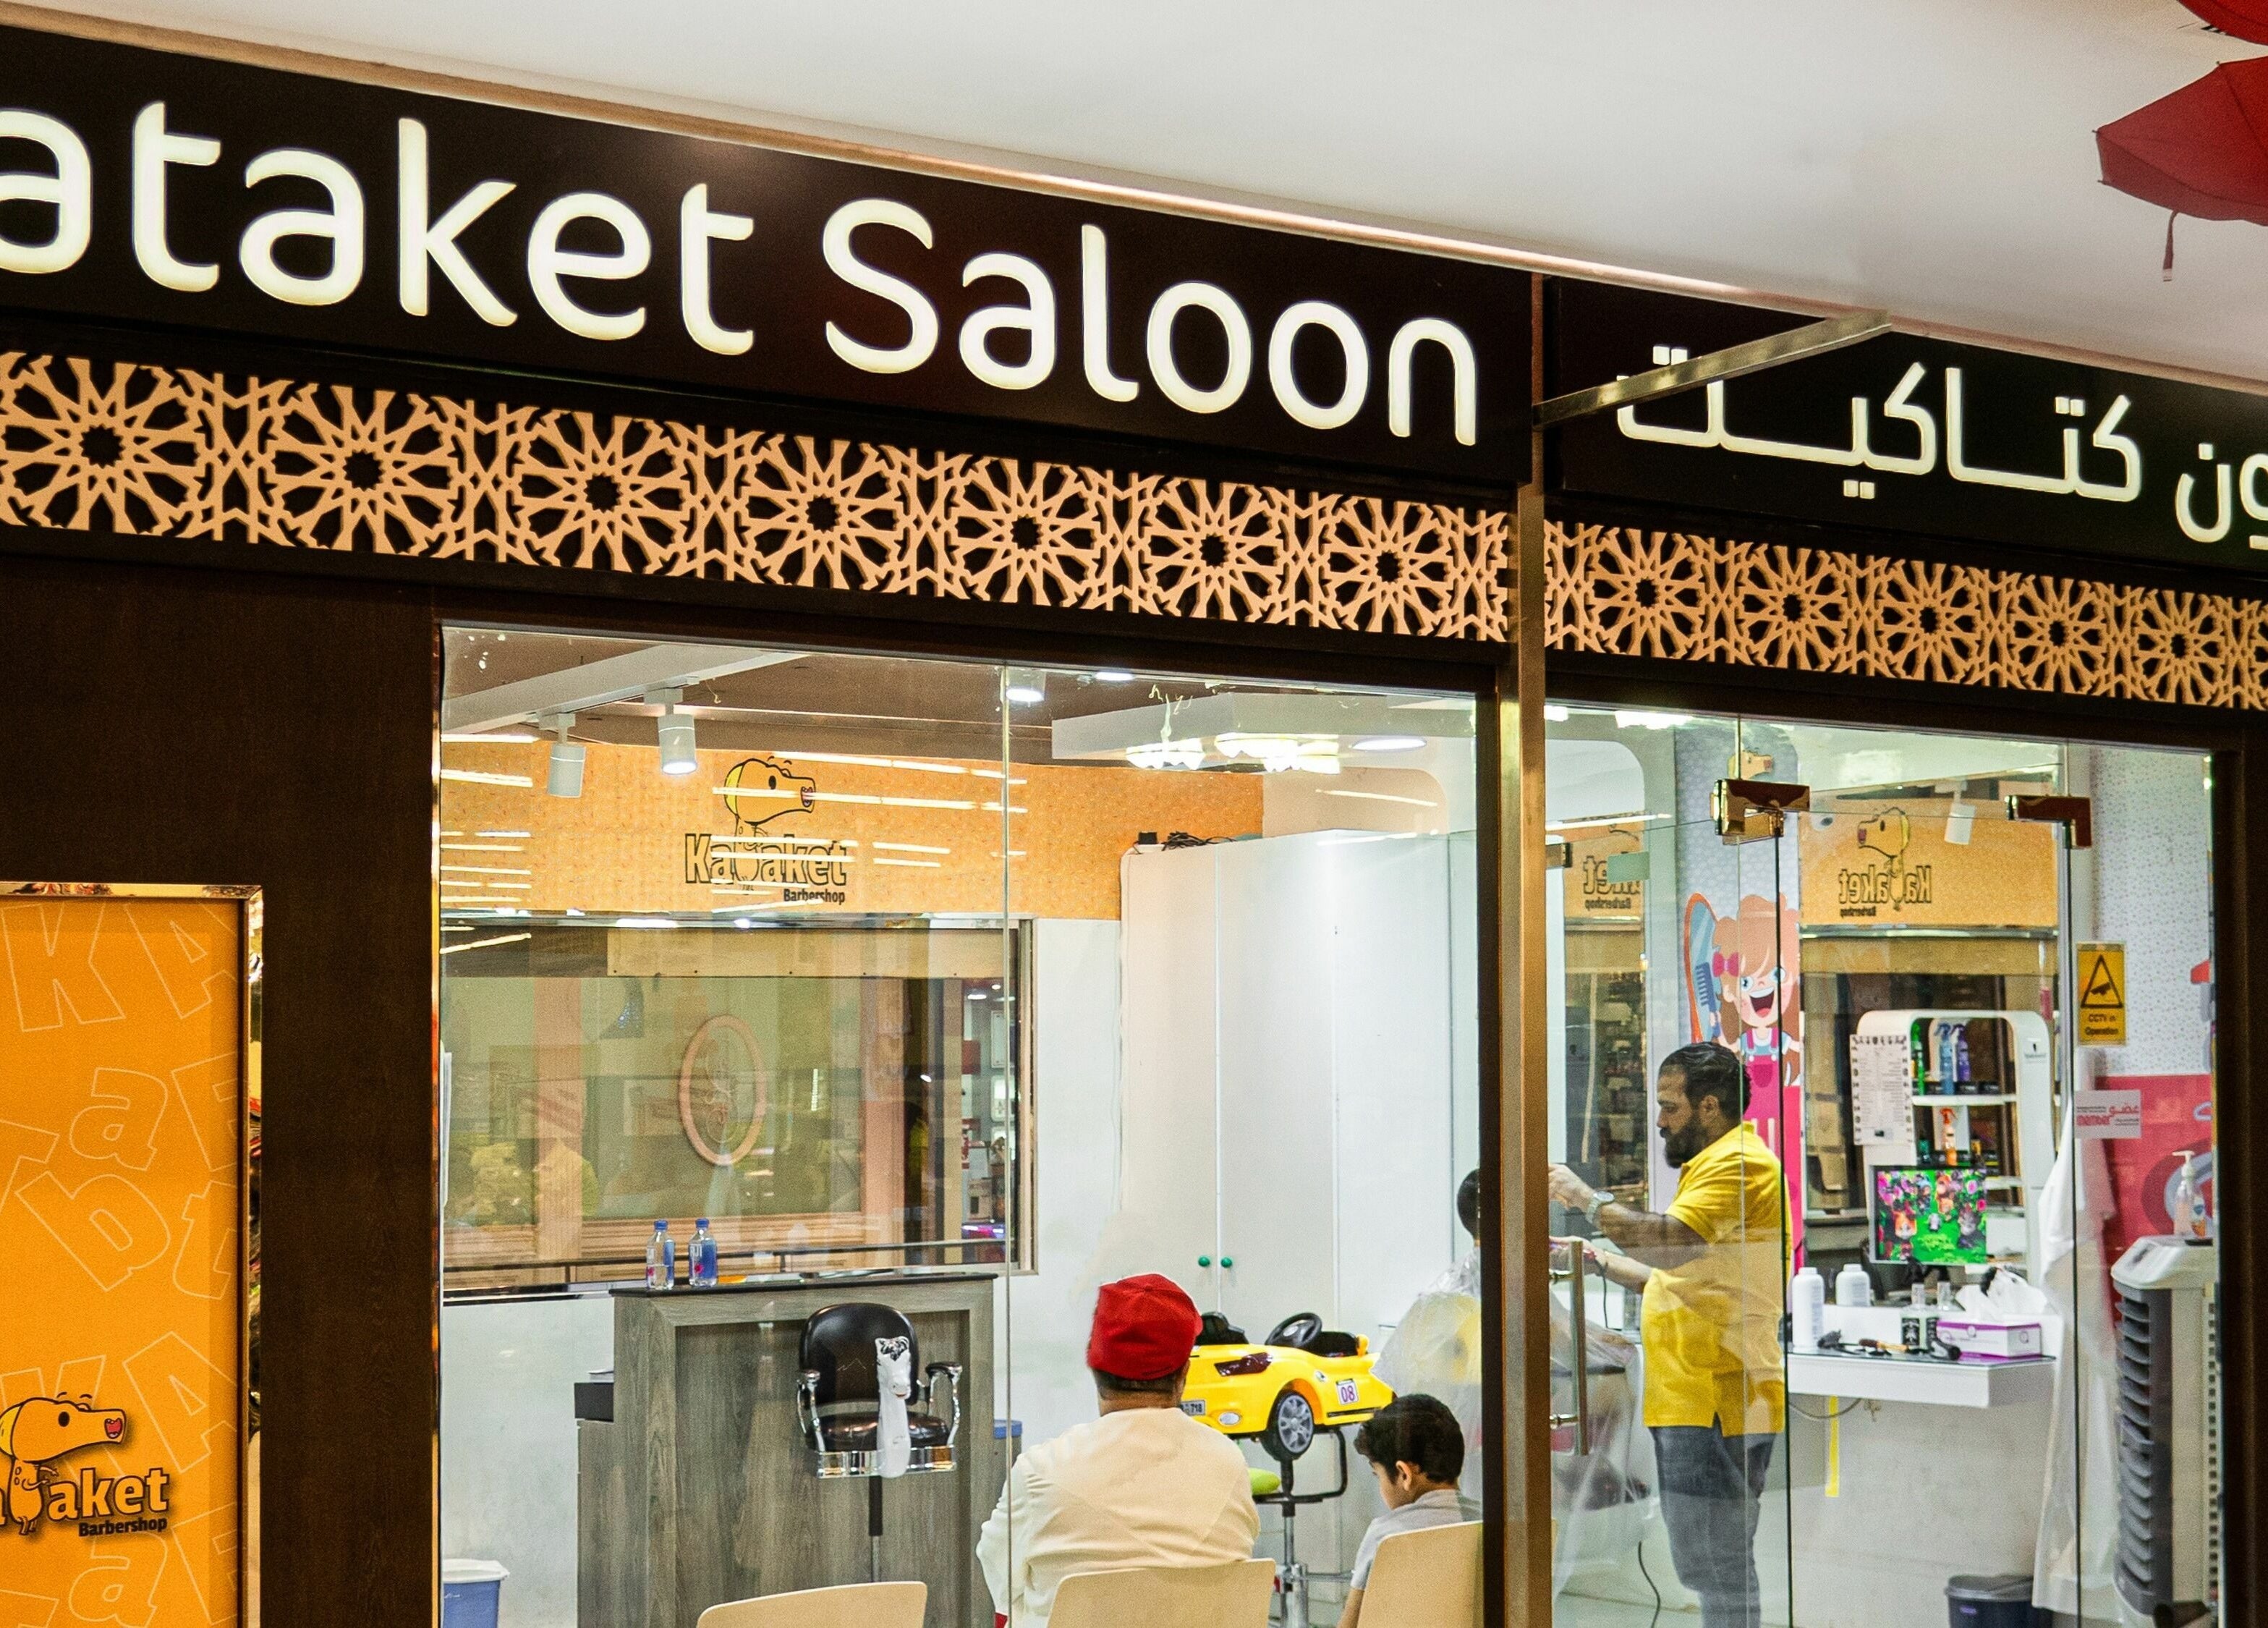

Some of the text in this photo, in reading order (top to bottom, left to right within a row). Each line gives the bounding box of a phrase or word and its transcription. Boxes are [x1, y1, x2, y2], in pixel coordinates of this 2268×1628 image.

[823, 198, 1477, 446] Saloon
[783, 889, 846, 905] Barbershop
[1341, 1385, 1355, 1402] 08
[78, 1517, 168, 1538] Barbershop
